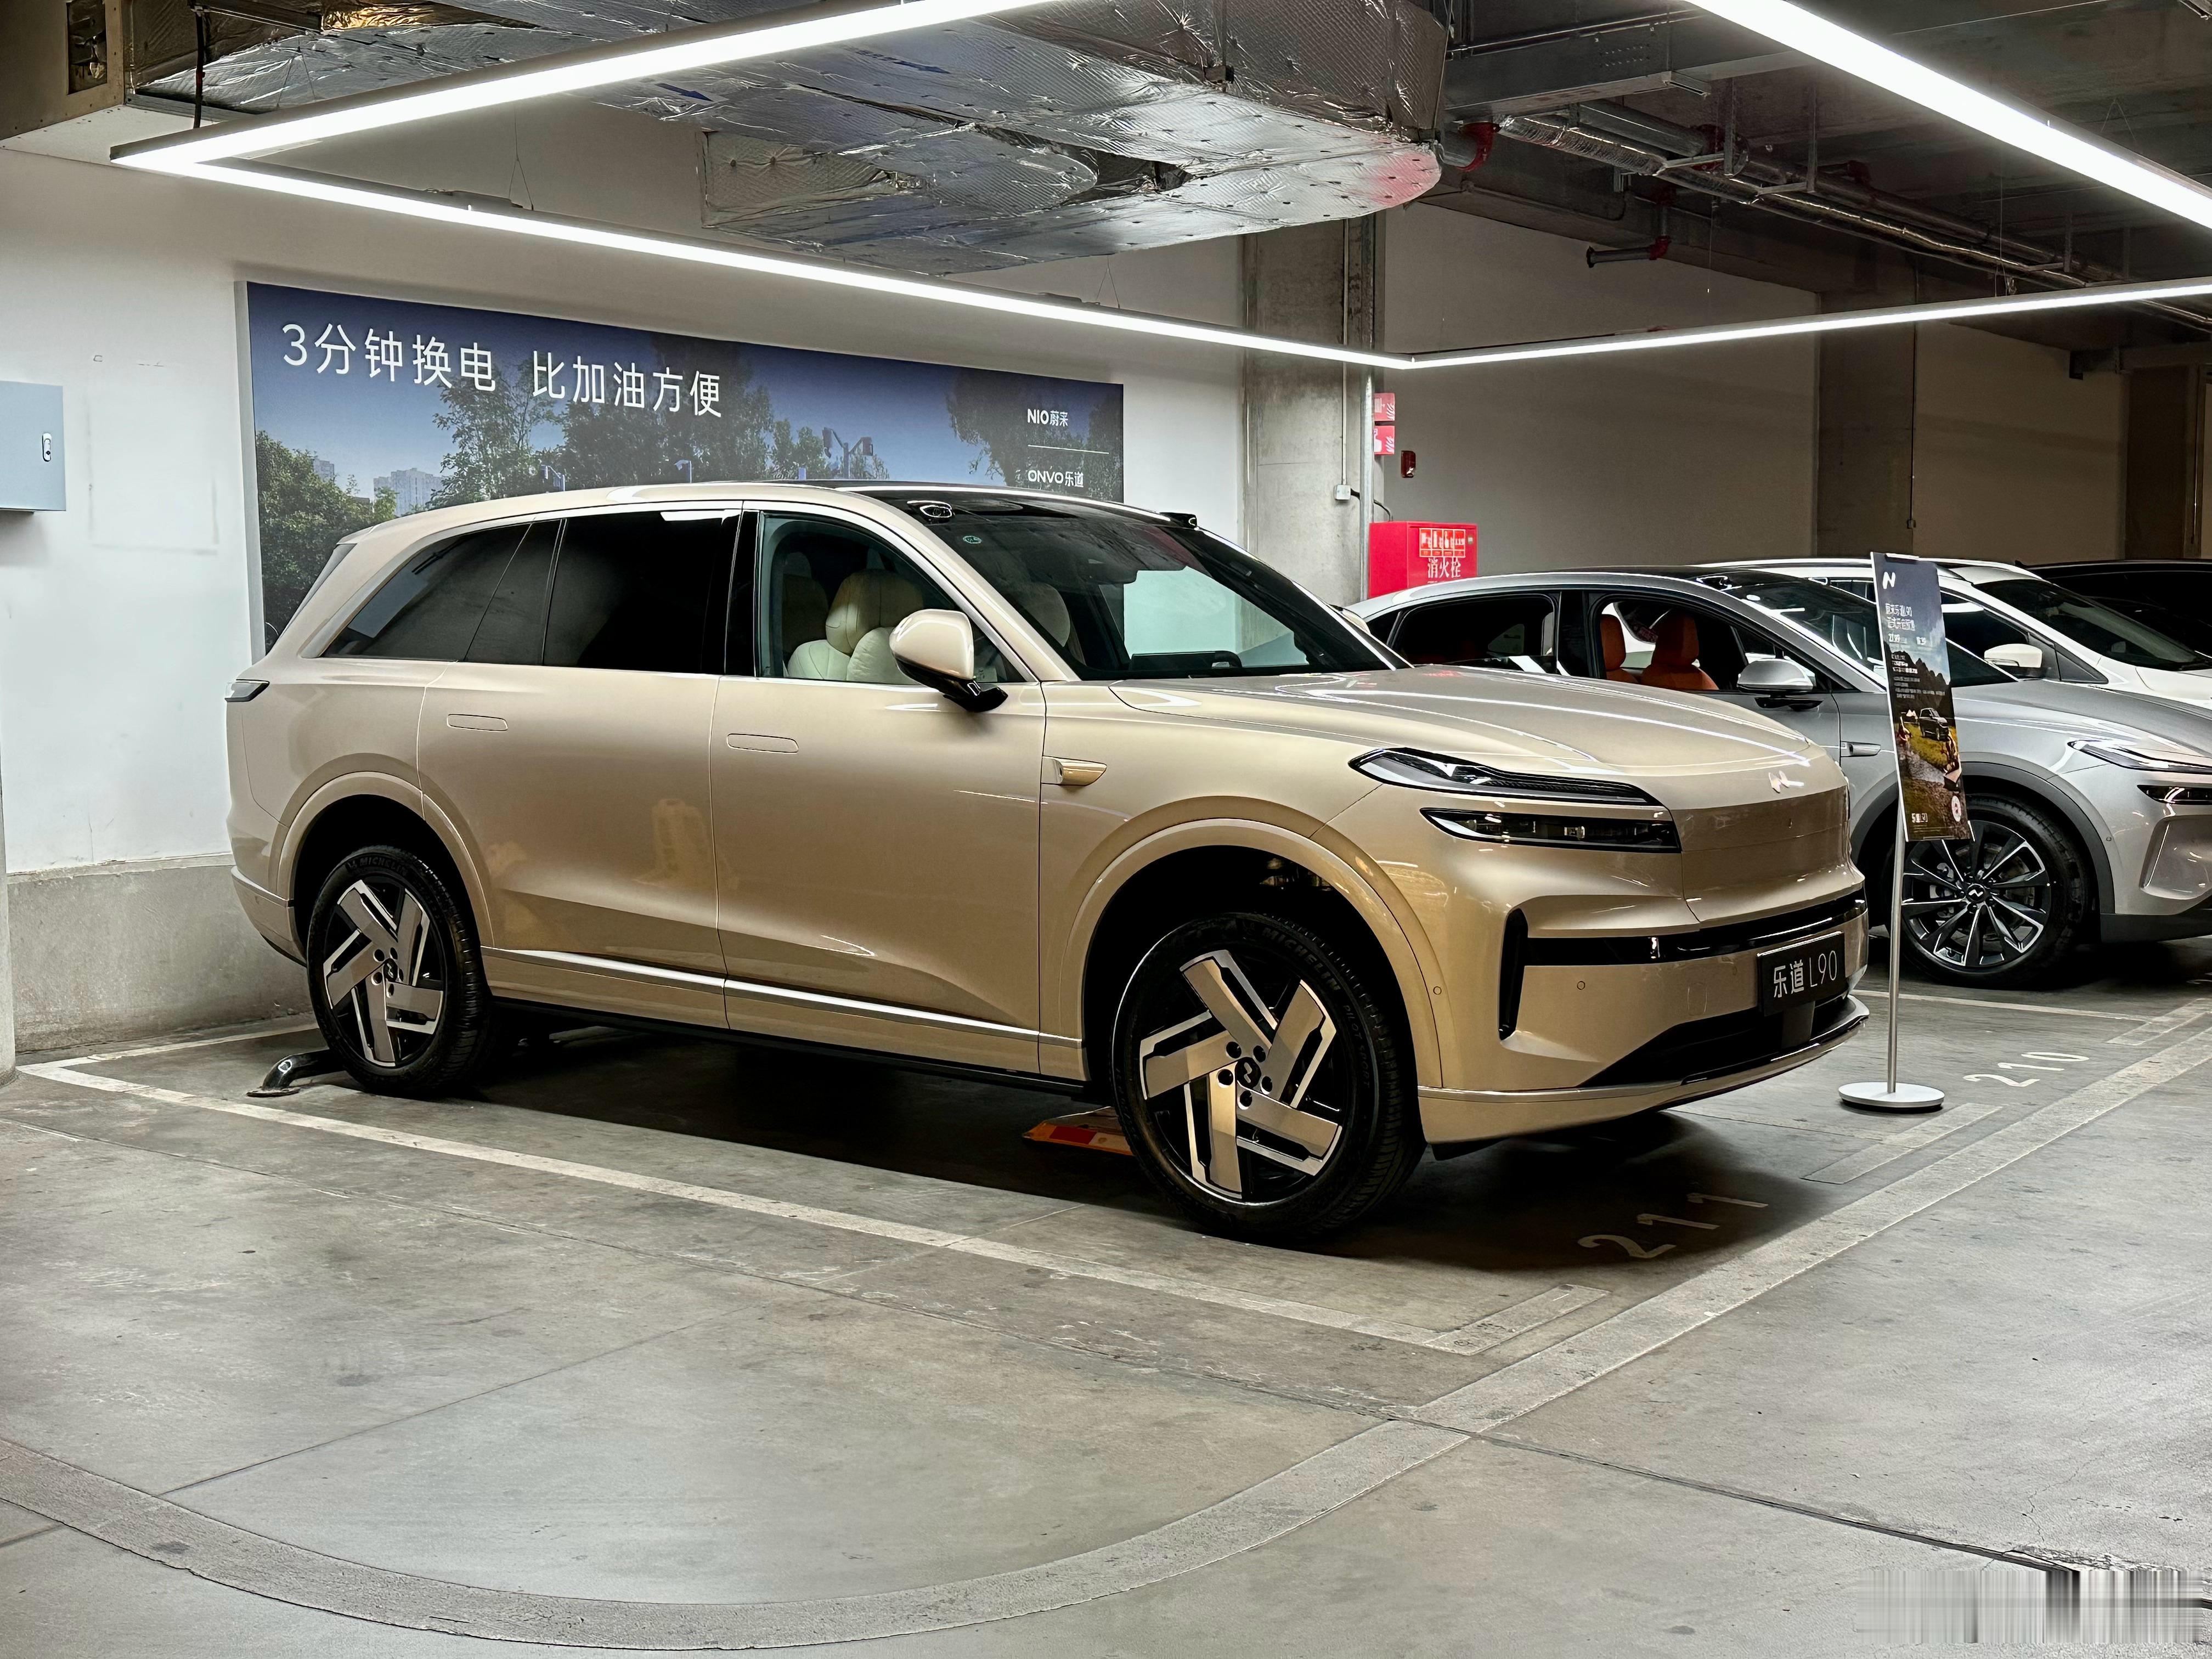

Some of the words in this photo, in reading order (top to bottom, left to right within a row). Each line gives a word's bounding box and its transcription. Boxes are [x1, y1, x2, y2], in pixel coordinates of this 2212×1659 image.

[281, 323, 496, 393] 3分钟换电
[532, 350, 723, 418] 比加油方便
[1427, 556, 1462, 579] 消火栓
[1261, 927, 1342, 991] MICHELIN
[1773, 959, 1804, 998] 乐道
[1809, 950, 1837, 988] L90
[1962, 1051, 2090, 1087] 210
[1577, 1192, 1769, 1259] 211
